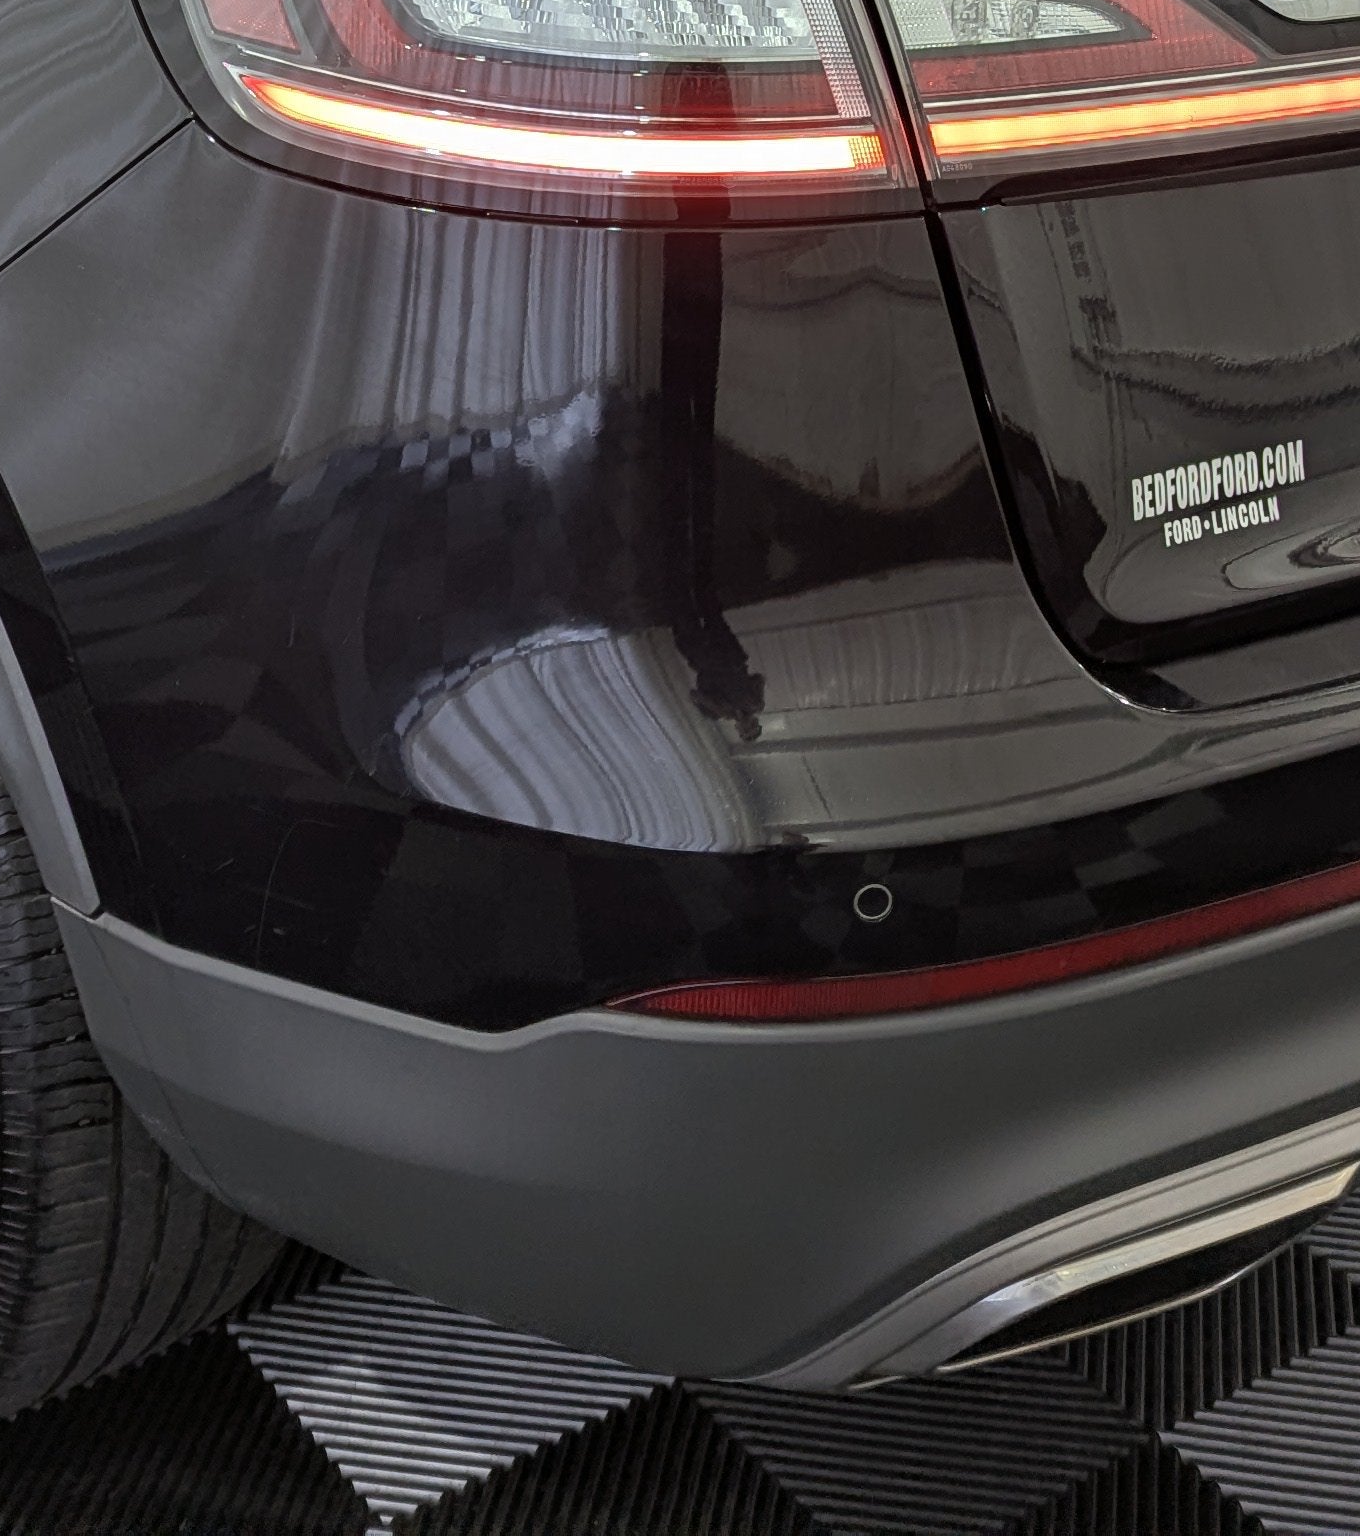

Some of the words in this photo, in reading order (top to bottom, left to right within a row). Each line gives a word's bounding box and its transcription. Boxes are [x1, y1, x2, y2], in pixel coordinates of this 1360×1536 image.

[1131, 439, 1306, 521] BEDFORDFORD.COM
[1164, 519, 1203, 548] FORD
[1211, 495, 1281, 535] LINCOLN
